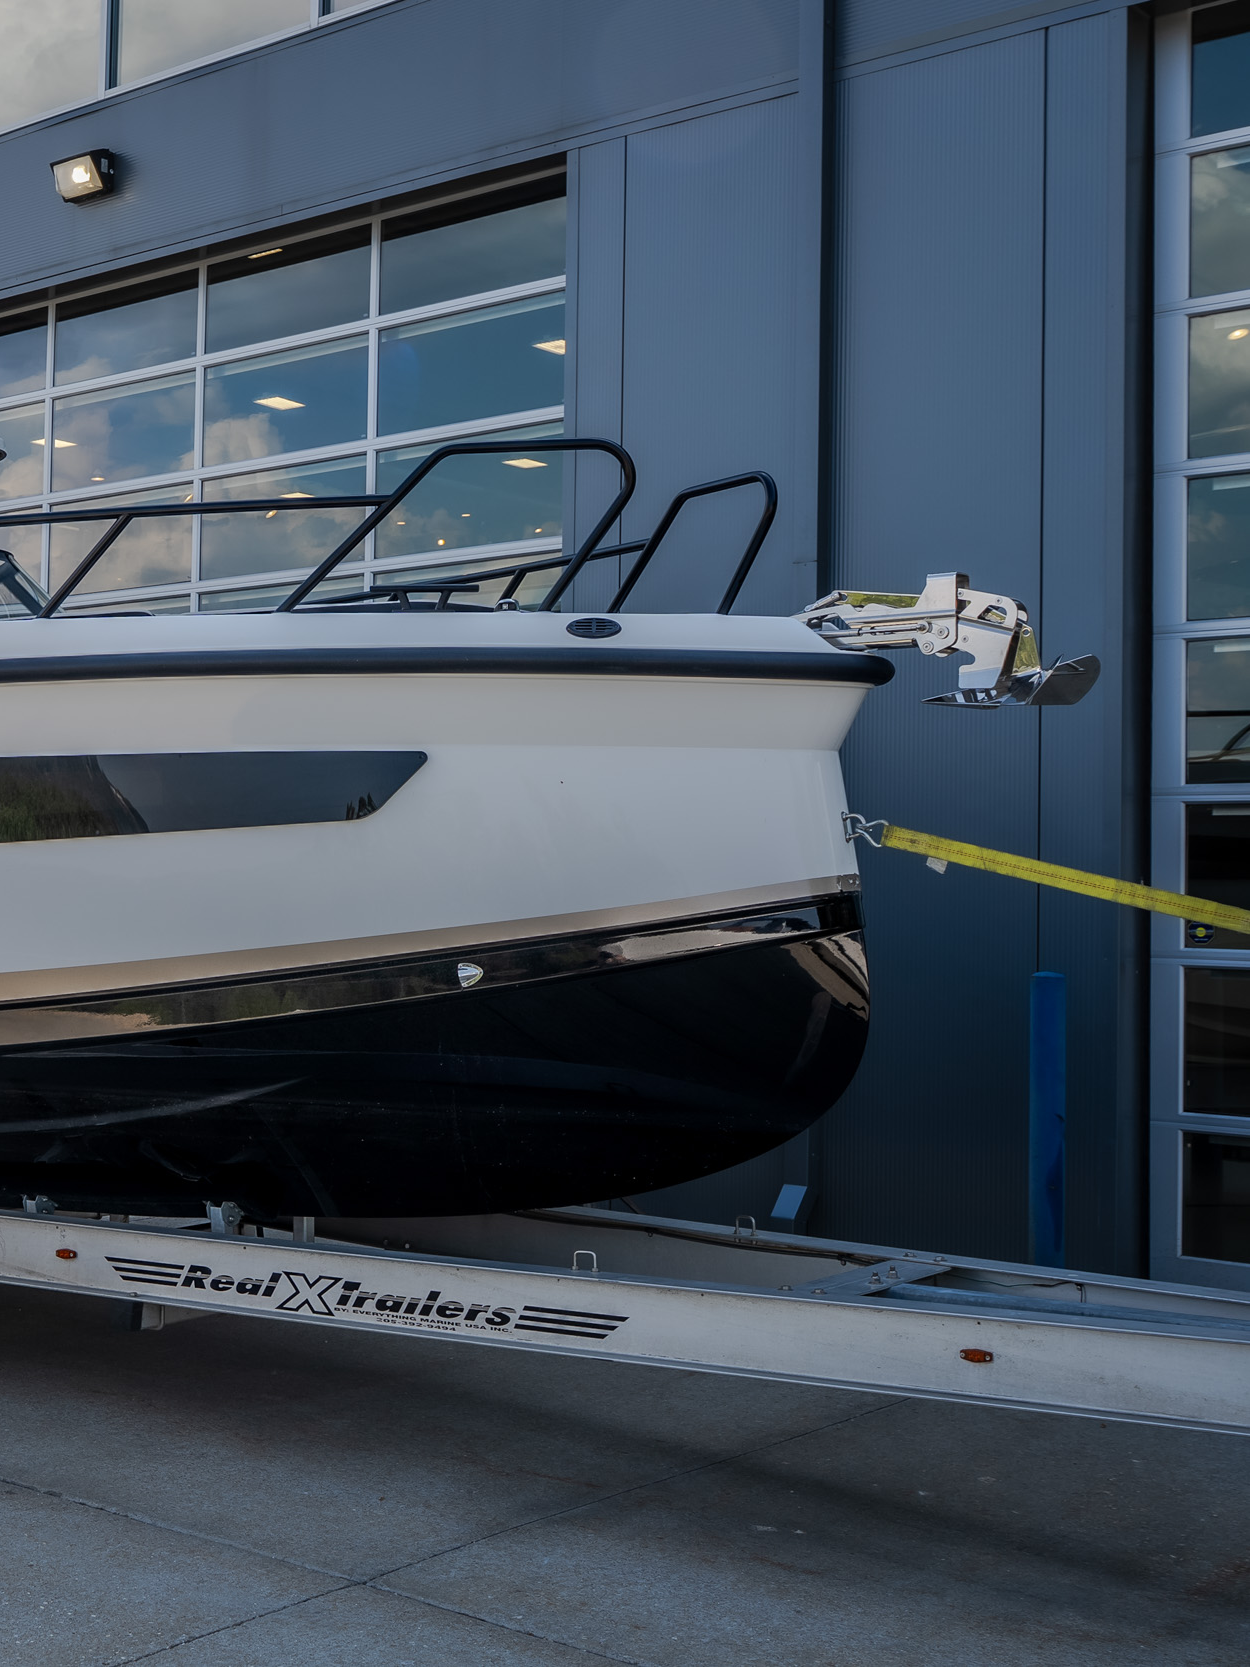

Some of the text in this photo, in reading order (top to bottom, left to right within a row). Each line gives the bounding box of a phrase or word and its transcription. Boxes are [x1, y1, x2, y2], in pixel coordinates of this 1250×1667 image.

[181, 1264, 282, 1298] Real
[336, 1280, 517, 1327] Trailers
[352, 1309, 417, 1322] EVERYTHING
[420, 1317, 462, 1328] MARINE
[465, 1323, 487, 1331] USA
[490, 1326, 513, 1334] INC.
[376, 1317, 457, 1332] 205-392-9494
